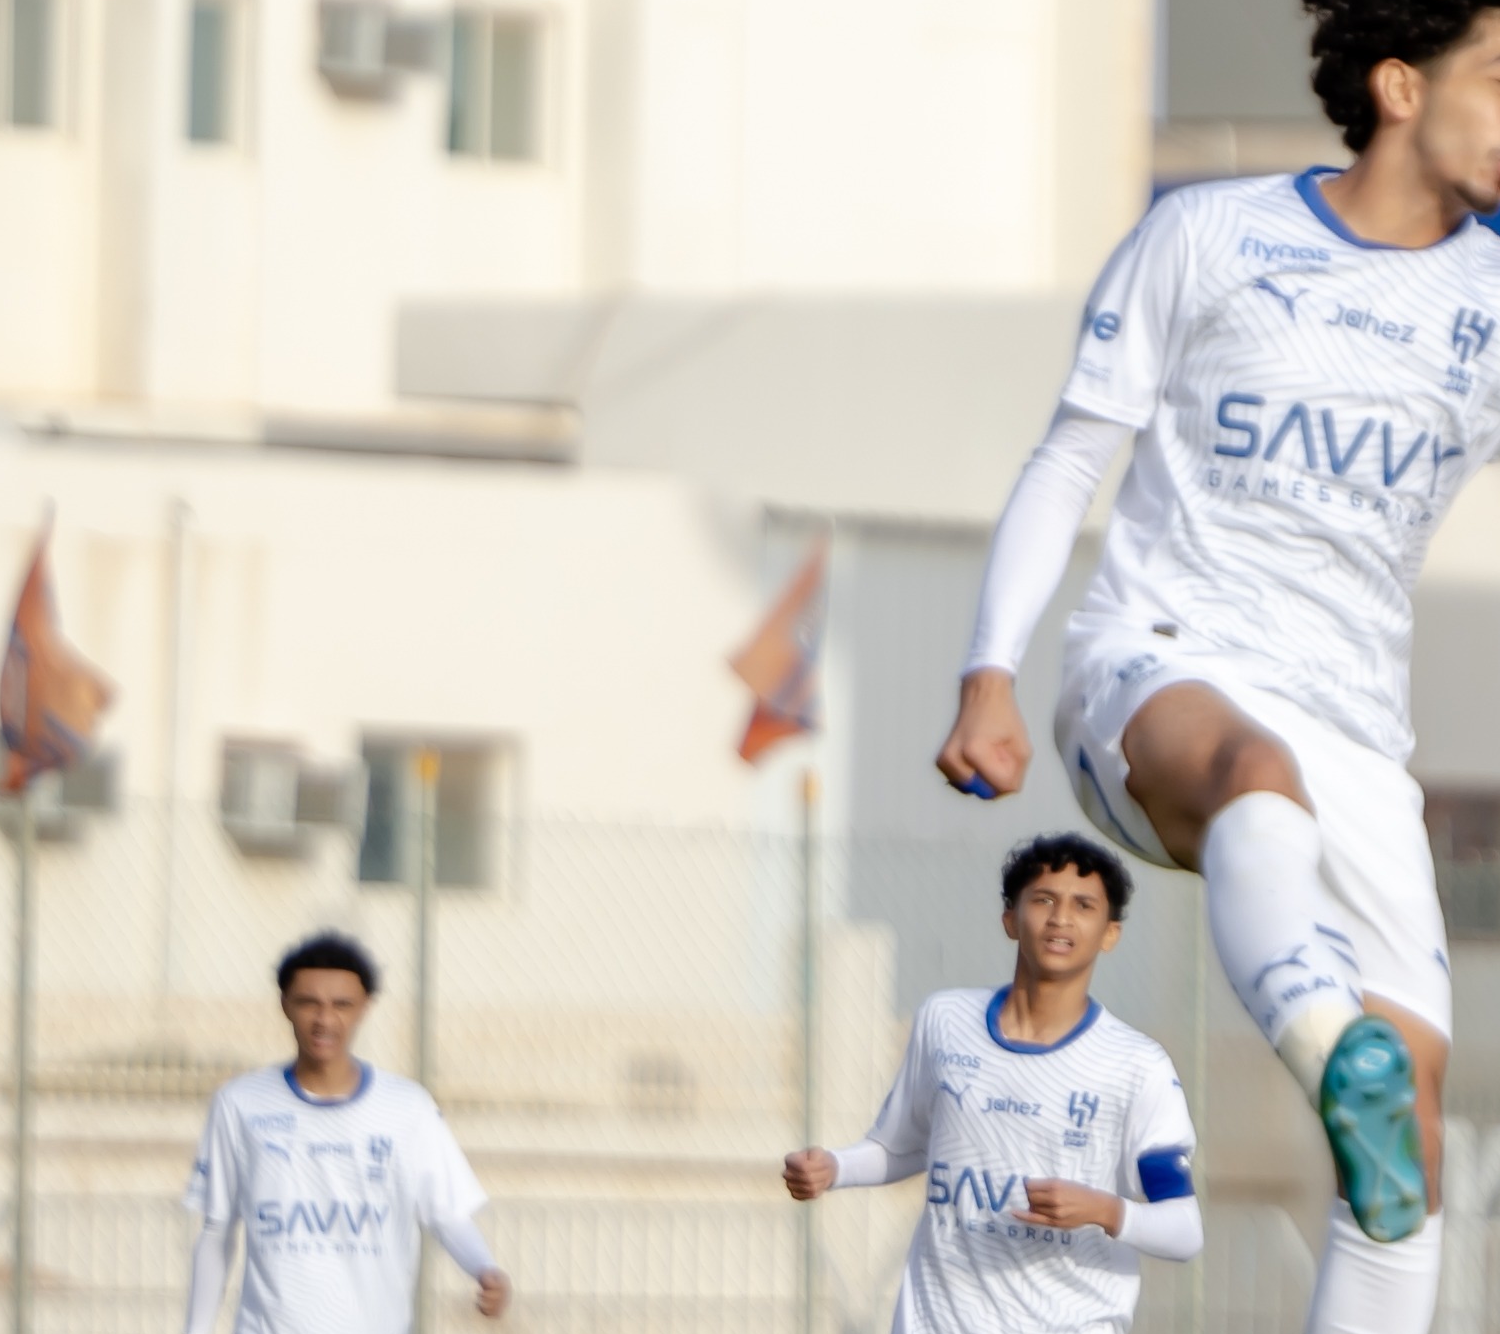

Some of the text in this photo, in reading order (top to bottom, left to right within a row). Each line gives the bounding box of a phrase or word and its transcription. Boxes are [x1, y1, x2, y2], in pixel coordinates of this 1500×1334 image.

[1214, 391, 1466, 499] SAVVY
[1208, 468, 1332, 502] GAMES
[928, 1161, 1029, 1212] SAV
[256, 1200, 390, 1238] SAVVY
